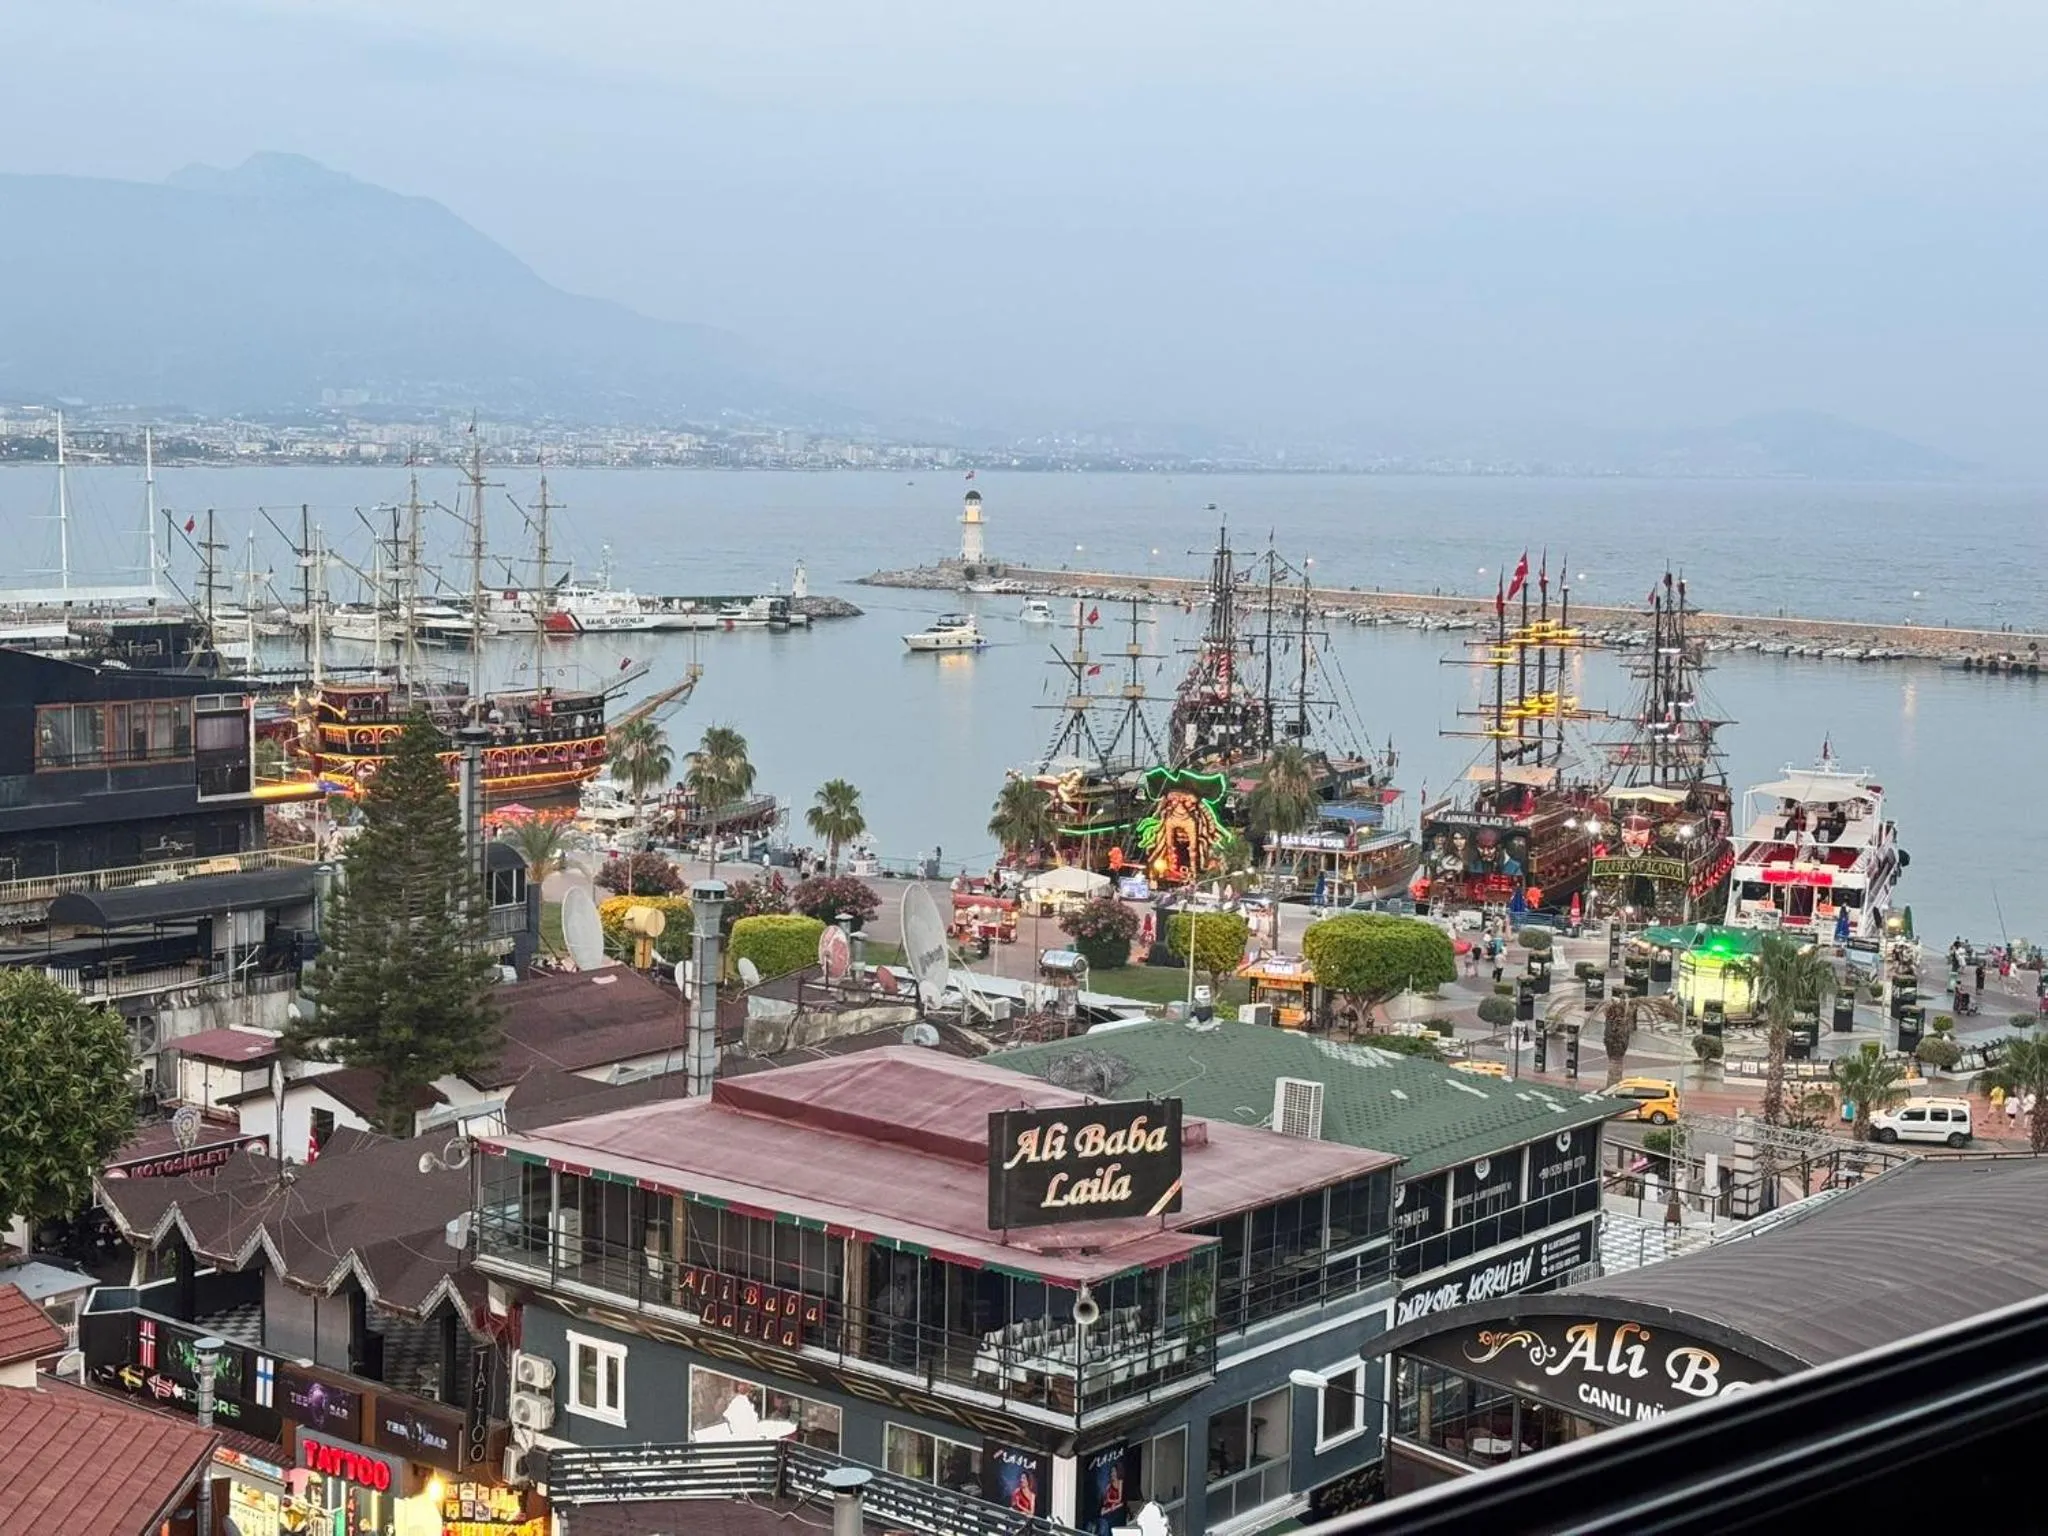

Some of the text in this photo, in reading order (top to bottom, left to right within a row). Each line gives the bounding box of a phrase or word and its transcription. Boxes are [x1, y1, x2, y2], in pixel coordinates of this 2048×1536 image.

[1596, 860, 1631, 874] PIRATES
[1632, 859, 1645, 873] OF
[1003, 1115, 1168, 1170] Ali Baba
[1040, 1162, 1132, 1208] Laila
[679, 1270, 818, 1322] Ali Baba
[1397, 1282, 1463, 1326] DARKSIDE
[1466, 1259, 1512, 1302] KORKU
[702, 1302, 795, 1347] Laila
[1544, 1321, 1650, 1379] Ali
[471, 1351, 488, 1462] TATTOO
[1577, 1383, 1631, 1417] CANLI
[303, 1439, 391, 1491] TATTOO
